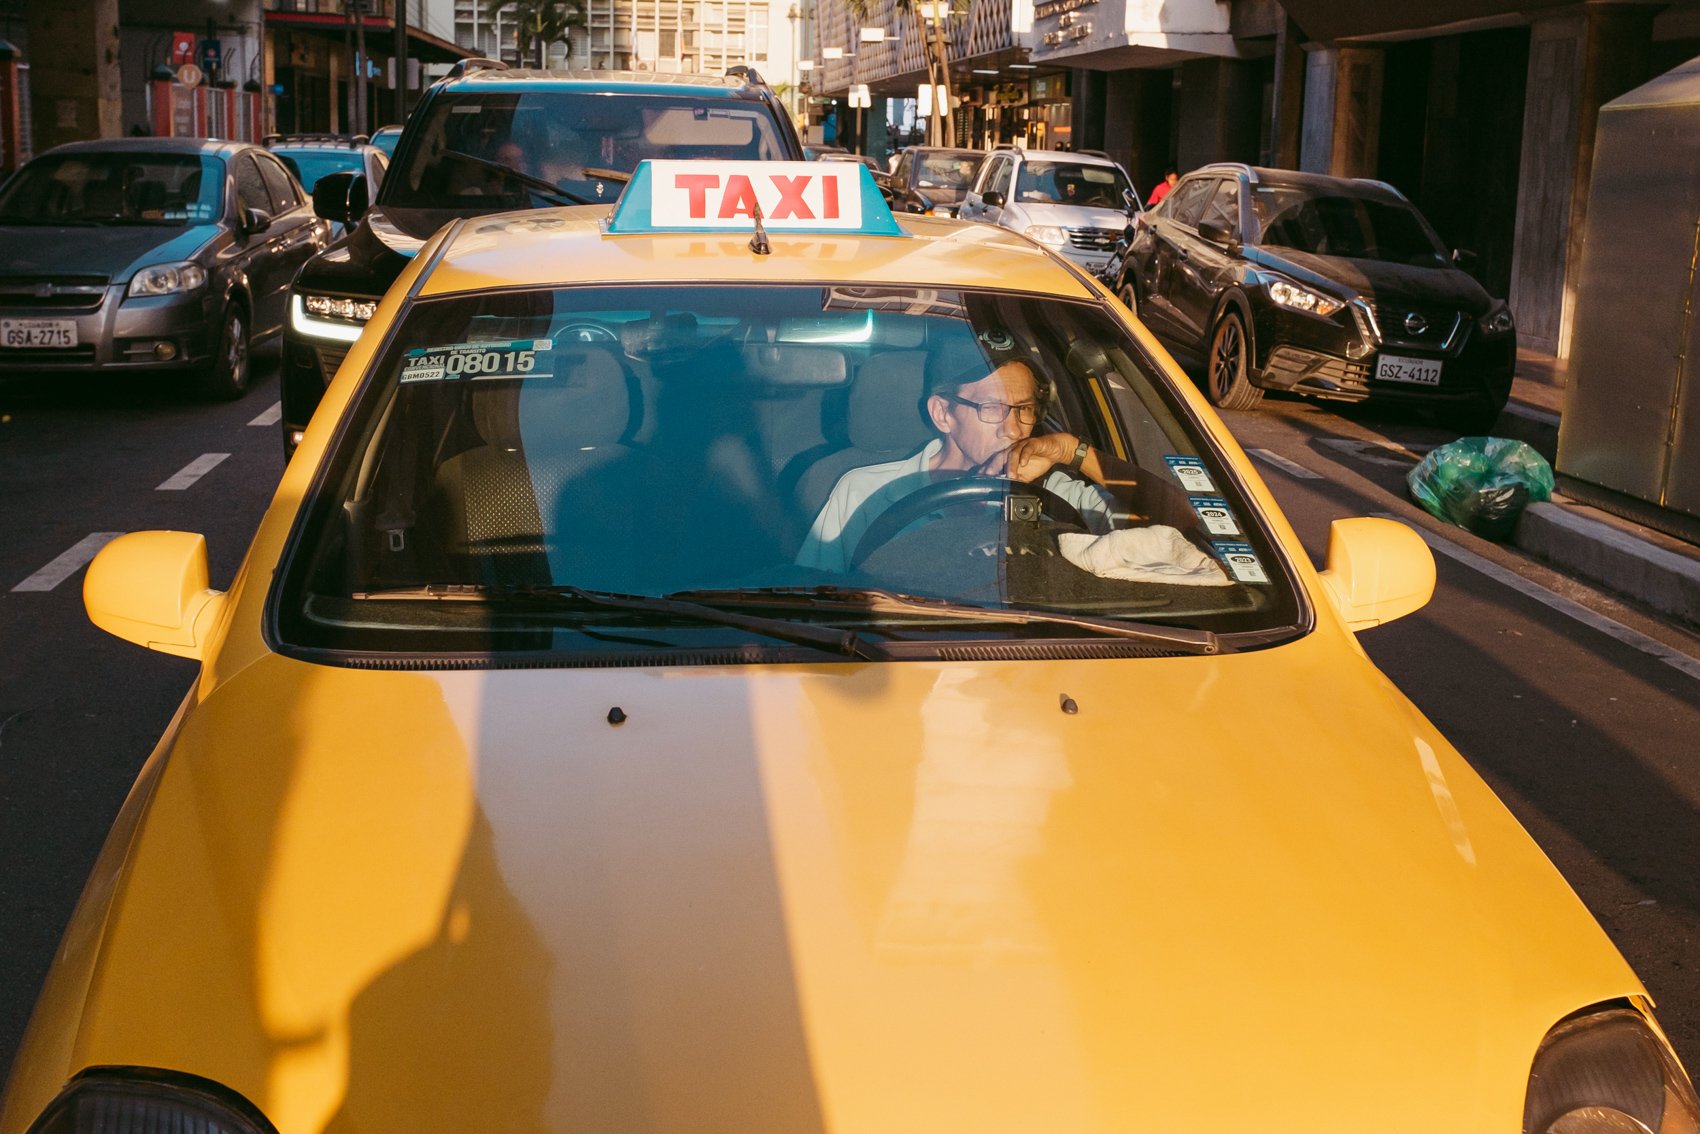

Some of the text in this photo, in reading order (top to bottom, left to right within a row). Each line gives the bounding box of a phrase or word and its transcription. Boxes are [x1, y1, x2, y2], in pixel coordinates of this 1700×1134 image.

[675, 174, 840, 219] TAXI
[7, 330, 71, 345] GSA-2715
[408, 355, 446, 367] TAXI
[401, 371, 440, 380] GBM0522
[1380, 363, 1439, 383] GSZ-4112
